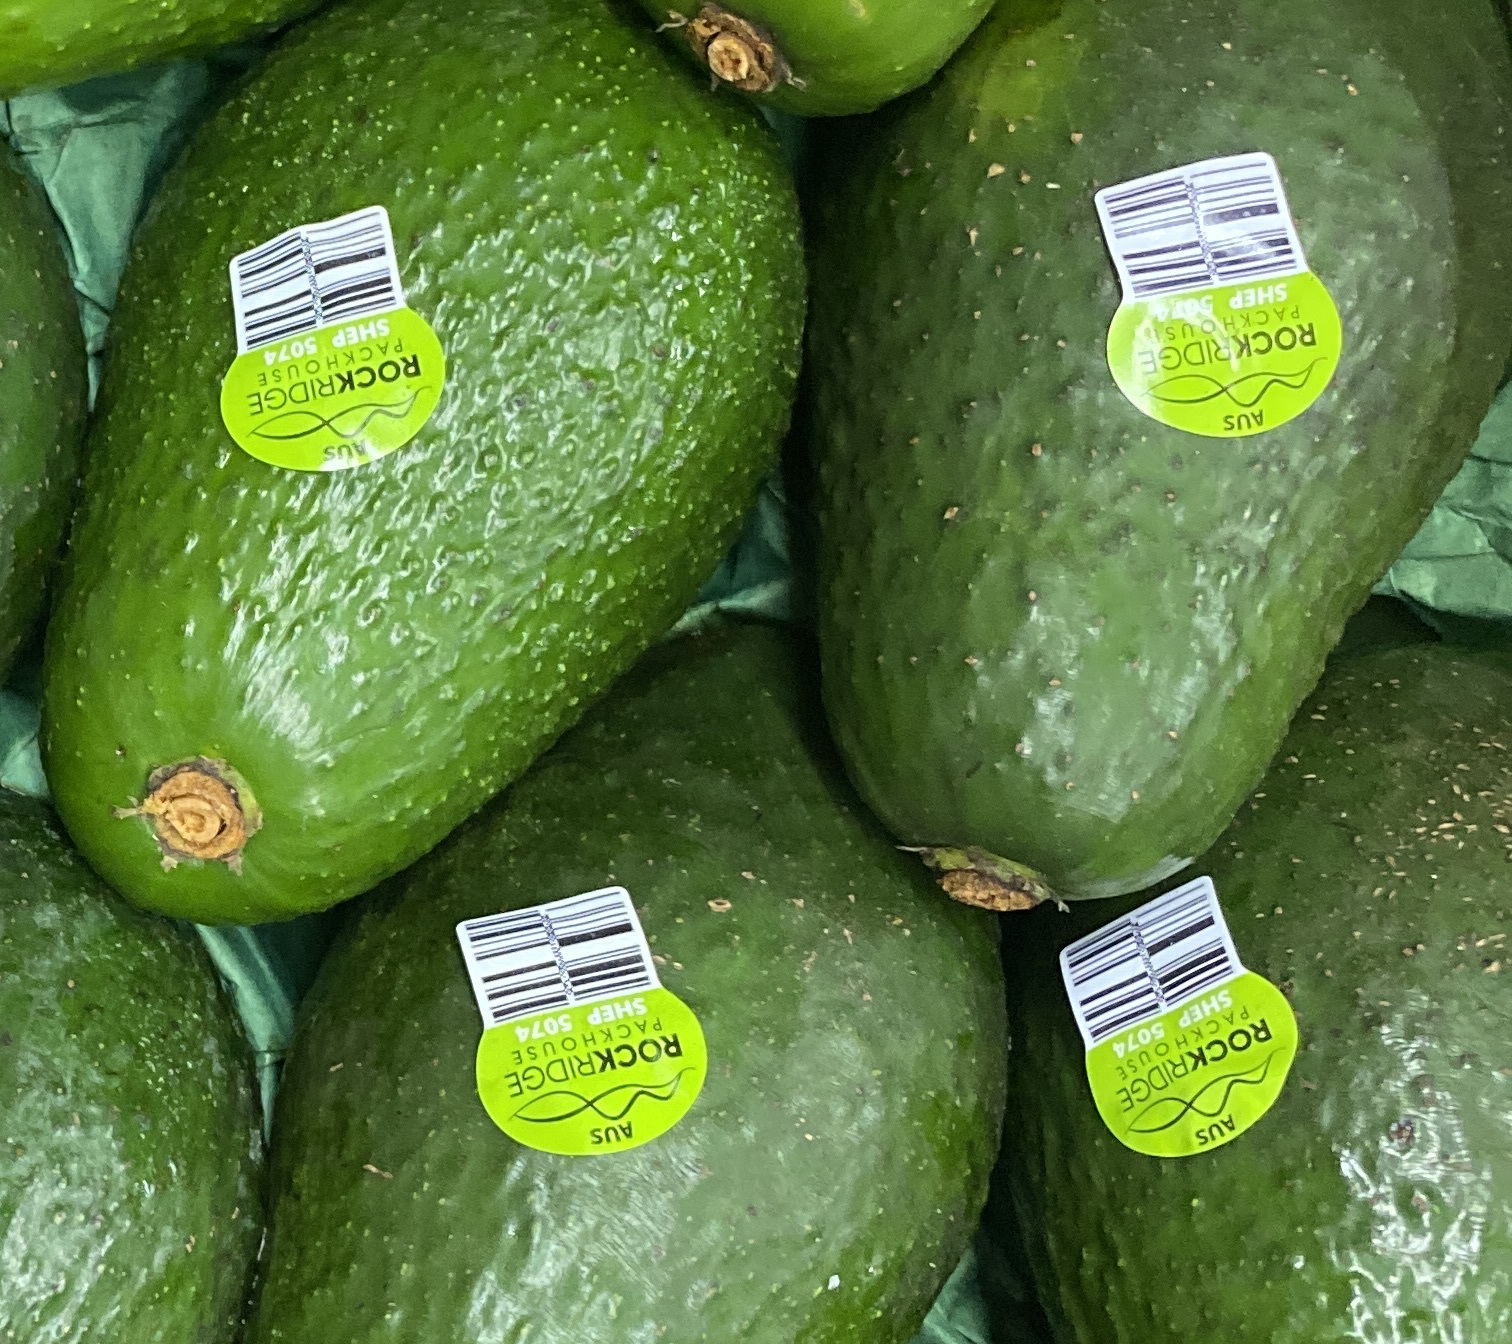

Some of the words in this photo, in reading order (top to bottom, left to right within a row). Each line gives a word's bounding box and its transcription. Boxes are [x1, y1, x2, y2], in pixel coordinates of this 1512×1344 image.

[1228, 283, 1288, 309] SHEP
[332, 318, 390, 348] SHEP
[1137, 322, 1317, 375] ROCKRIDGE
[256, 338, 403, 386] PACKHOUSE
[264, 337, 317, 365] 5074
[246, 354, 421, 416] ROCKRIDGE
[1223, 409, 1264, 431] AUS
[323, 439, 366, 461] AUS
[587, 998, 648, 1025] SHEP
[1178, 989, 1233, 1028] SHEP
[511, 1017, 662, 1065] PACKHOUSE
[514, 1014, 572, 1043] 5074
[1112, 1022, 1165, 1058] 5074
[1115, 1006, 1249, 1080] PACKHOUSE
[503, 1033, 683, 1098] ROCKRIDGE
[1116, 1018, 1272, 1113] ROCKRIDGE
[590, 1121, 633, 1145] AUS
[1195, 1114, 1236, 1146] AUS
